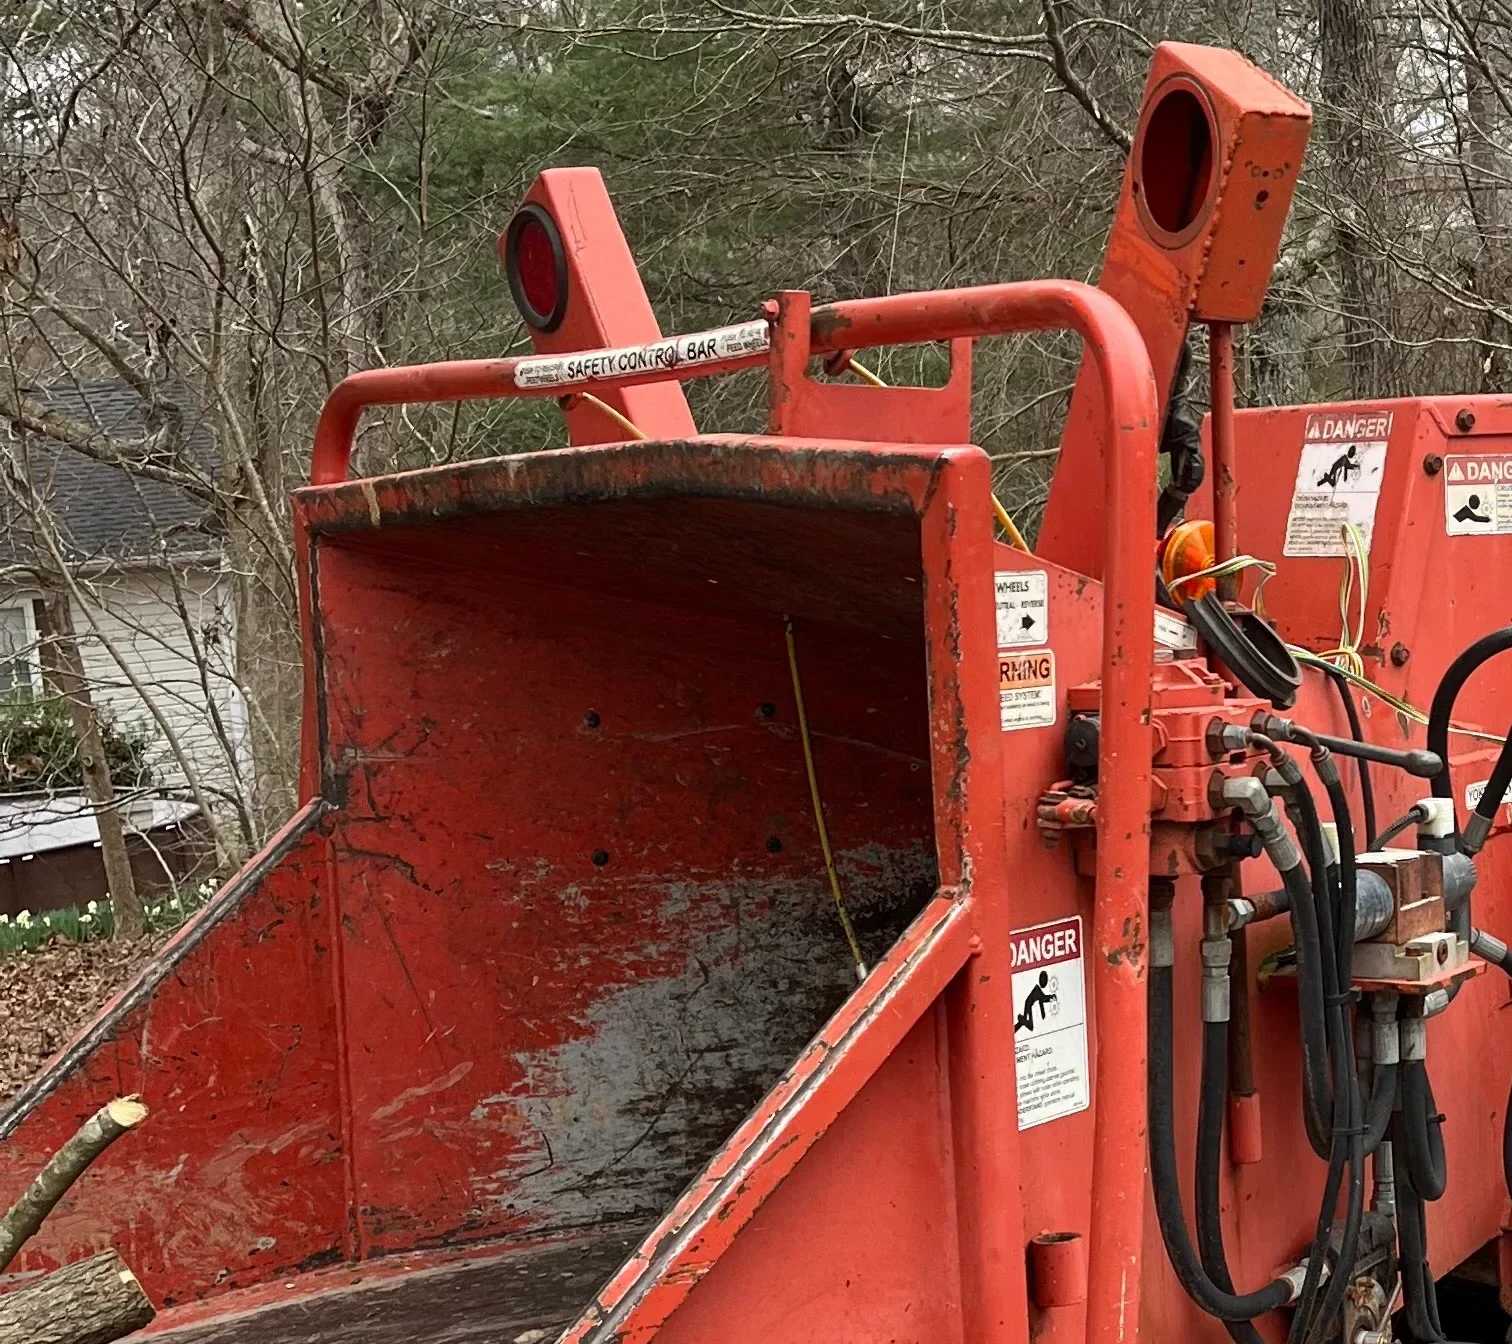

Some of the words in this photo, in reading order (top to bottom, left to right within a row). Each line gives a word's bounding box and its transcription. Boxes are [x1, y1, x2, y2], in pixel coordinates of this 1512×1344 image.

[566, 355, 616, 379] SAFETY
[618, 341, 684, 370] CONTROL
[687, 337, 718, 361] BAR
[1322, 417, 1387, 439] DANGER
[996, 580, 1030, 594] WHEELS
[1000, 657, 1051, 682] RNING
[1468, 786, 1485, 802] YOK
